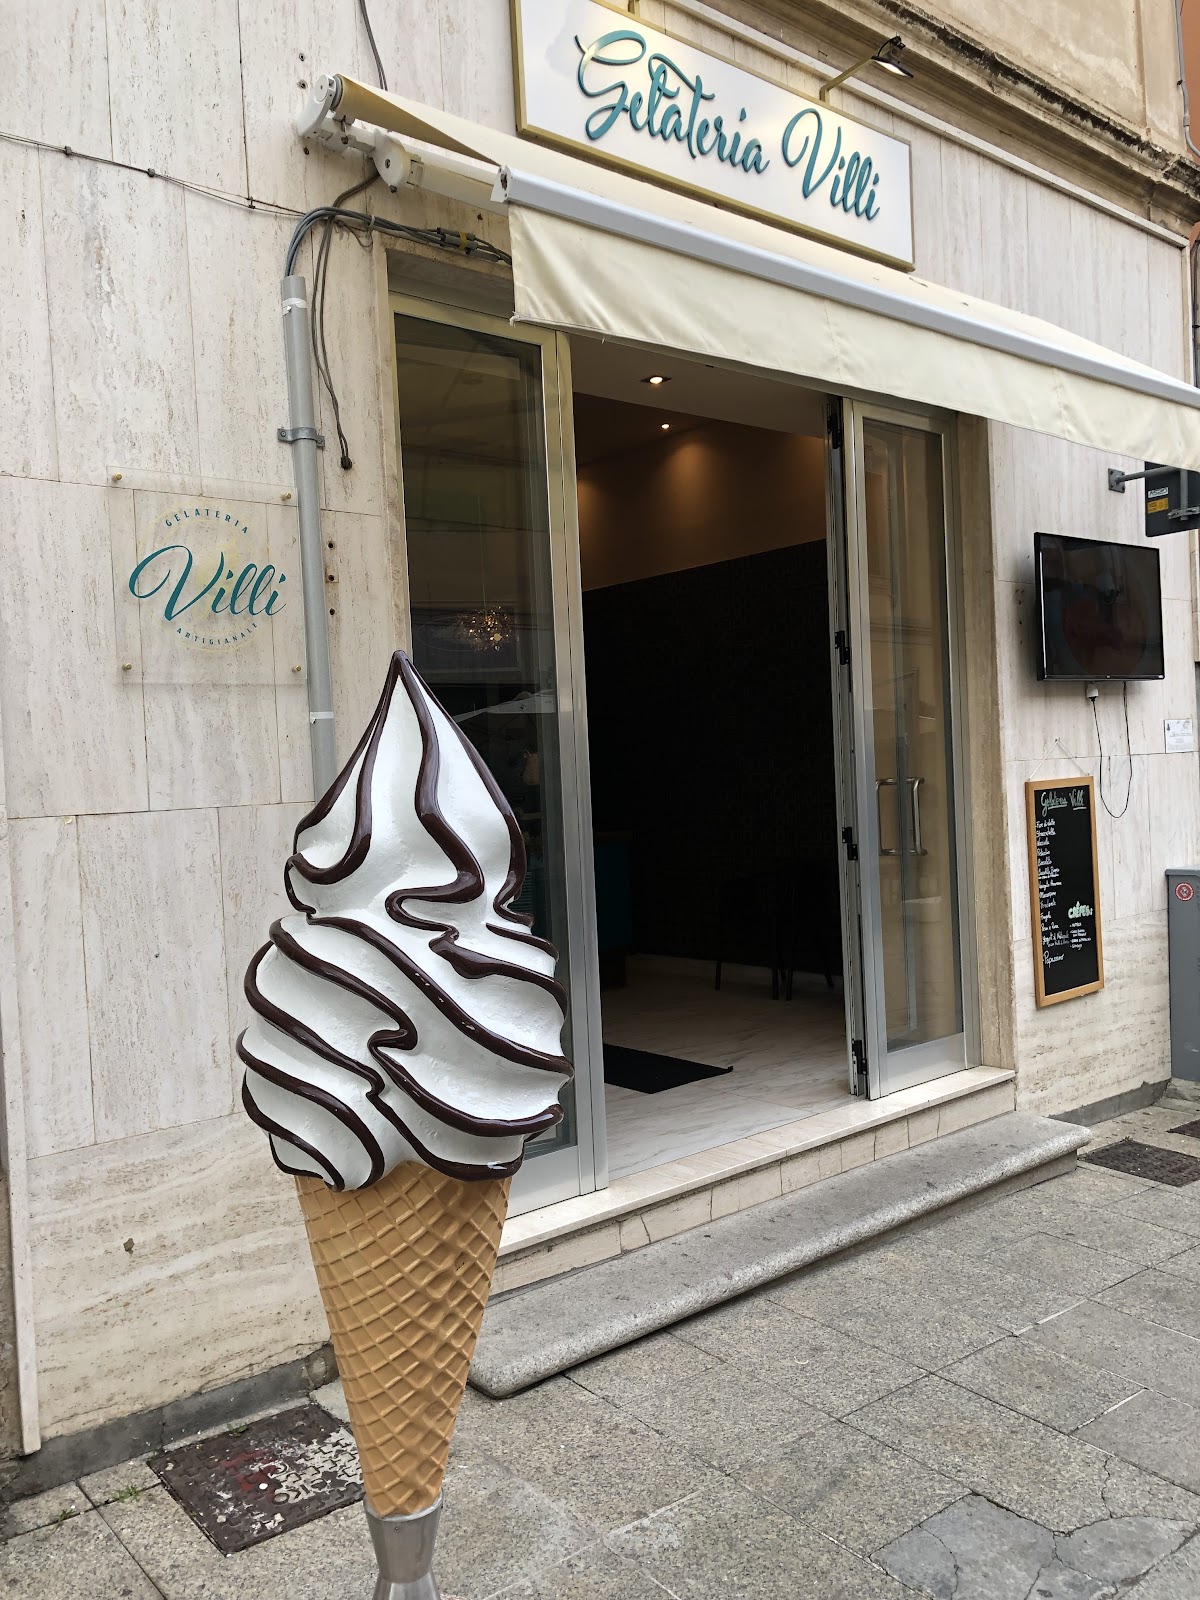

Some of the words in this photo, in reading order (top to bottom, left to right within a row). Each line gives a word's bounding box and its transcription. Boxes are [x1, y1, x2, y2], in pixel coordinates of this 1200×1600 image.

[574, 29, 770, 175] Gelateria
[781, 107, 881, 222] Villi
[164, 508, 248, 534] GELATERIA
[128, 544, 287, 622] Villi
